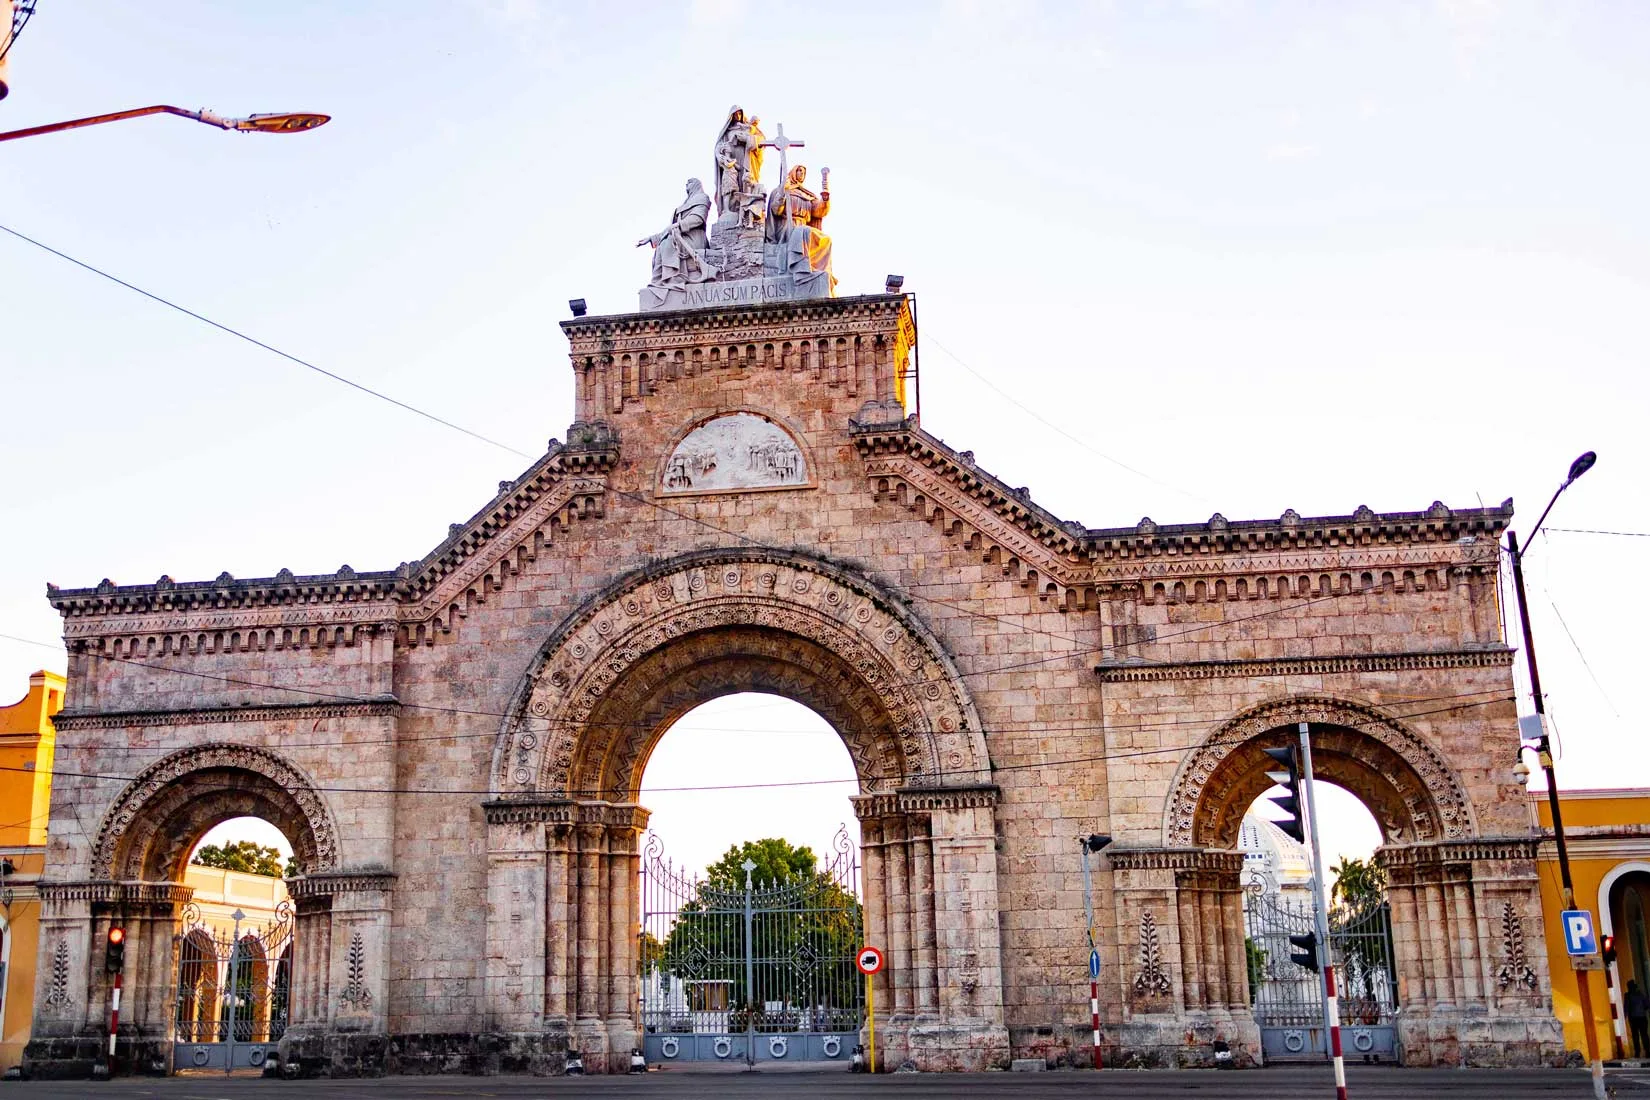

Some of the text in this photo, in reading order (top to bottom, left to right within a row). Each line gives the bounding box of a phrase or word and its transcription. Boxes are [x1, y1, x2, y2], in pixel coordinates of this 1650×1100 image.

[682, 283, 787, 304] JANUA SUM PACIS
[1568, 917, 1589, 949] P
